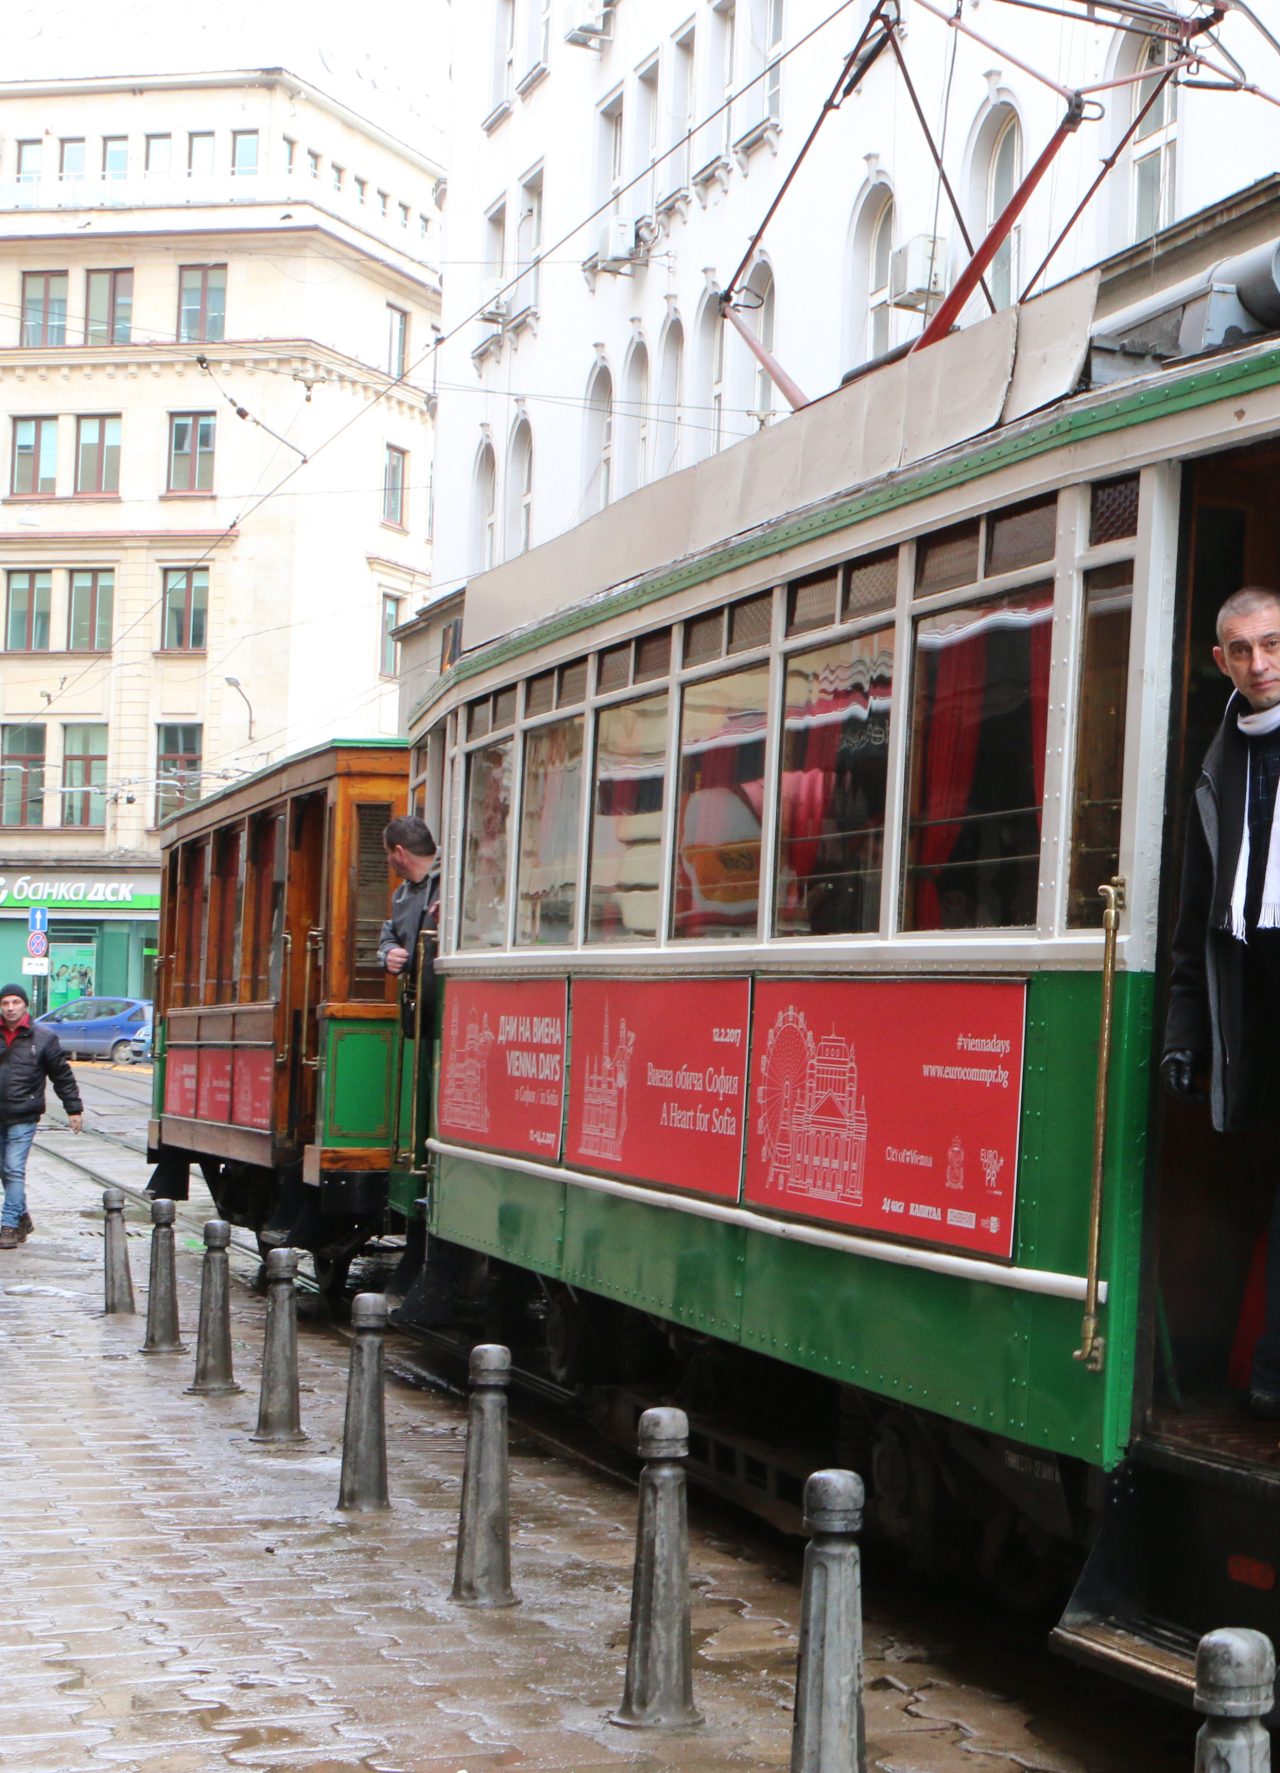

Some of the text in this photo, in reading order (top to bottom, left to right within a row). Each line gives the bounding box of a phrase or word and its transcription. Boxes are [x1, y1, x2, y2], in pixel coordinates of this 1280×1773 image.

[13, 876, 85, 900] банка
[498, 1015, 561, 1045] ДНИ НА ВИЕНА
[957, 1032, 1010, 1058] #viennadays
[506, 1050, 561, 1082] VIENNA DAYS
[923, 1064, 1009, 1088] www.eurocommpr.bg
[647, 1062, 739, 1101] Виена обича София
[660, 1102, 737, 1136] A Heart for Sofia
[985, 1169, 997, 1188] PR
